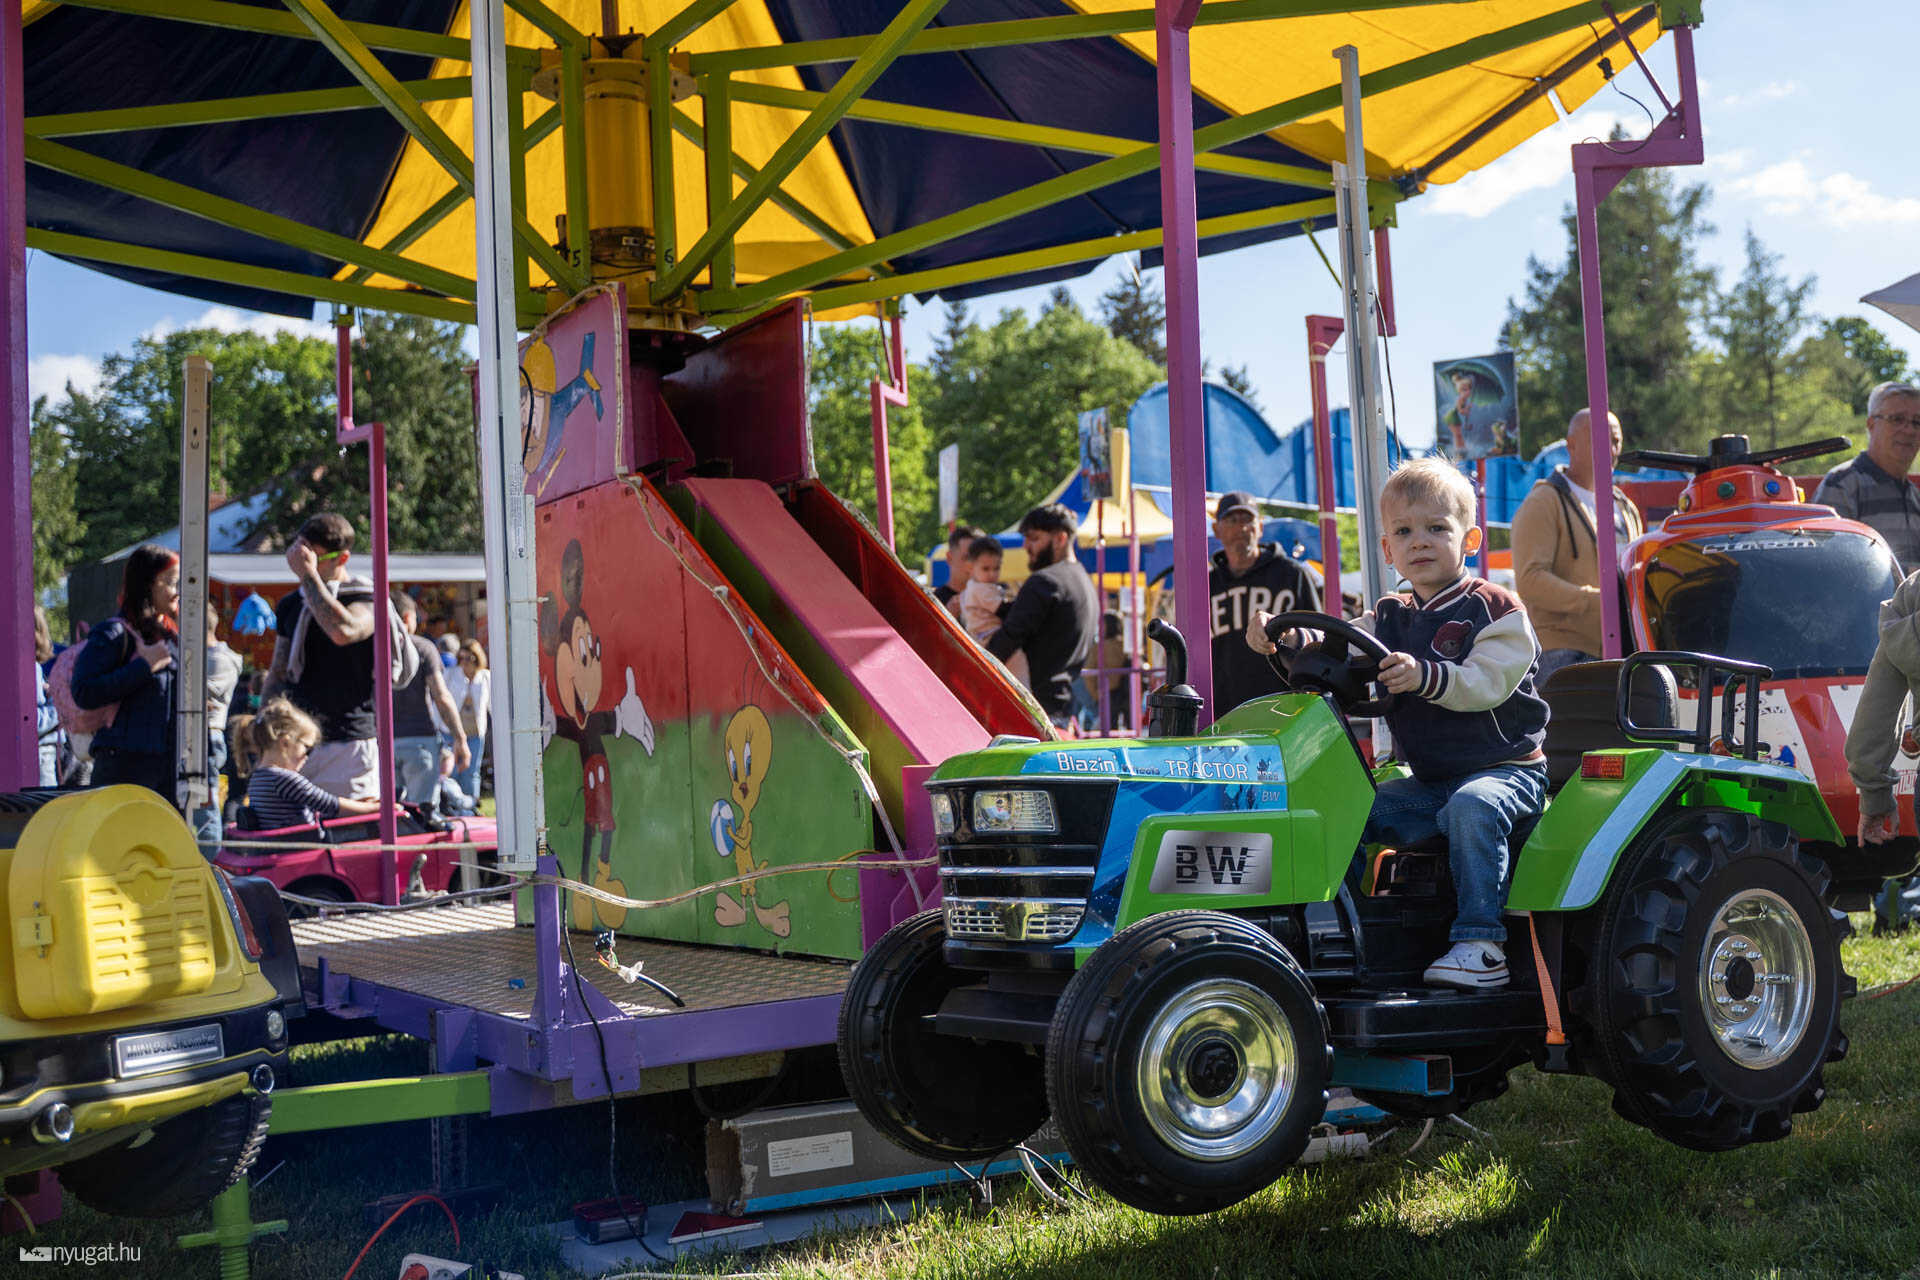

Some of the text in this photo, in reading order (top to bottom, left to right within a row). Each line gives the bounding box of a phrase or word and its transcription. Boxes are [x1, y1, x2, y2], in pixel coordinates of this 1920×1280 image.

[1209, 585, 1296, 639] ETRO
[1165, 759, 1249, 780] TRACTOR
[1175, 844, 1249, 885] BW
